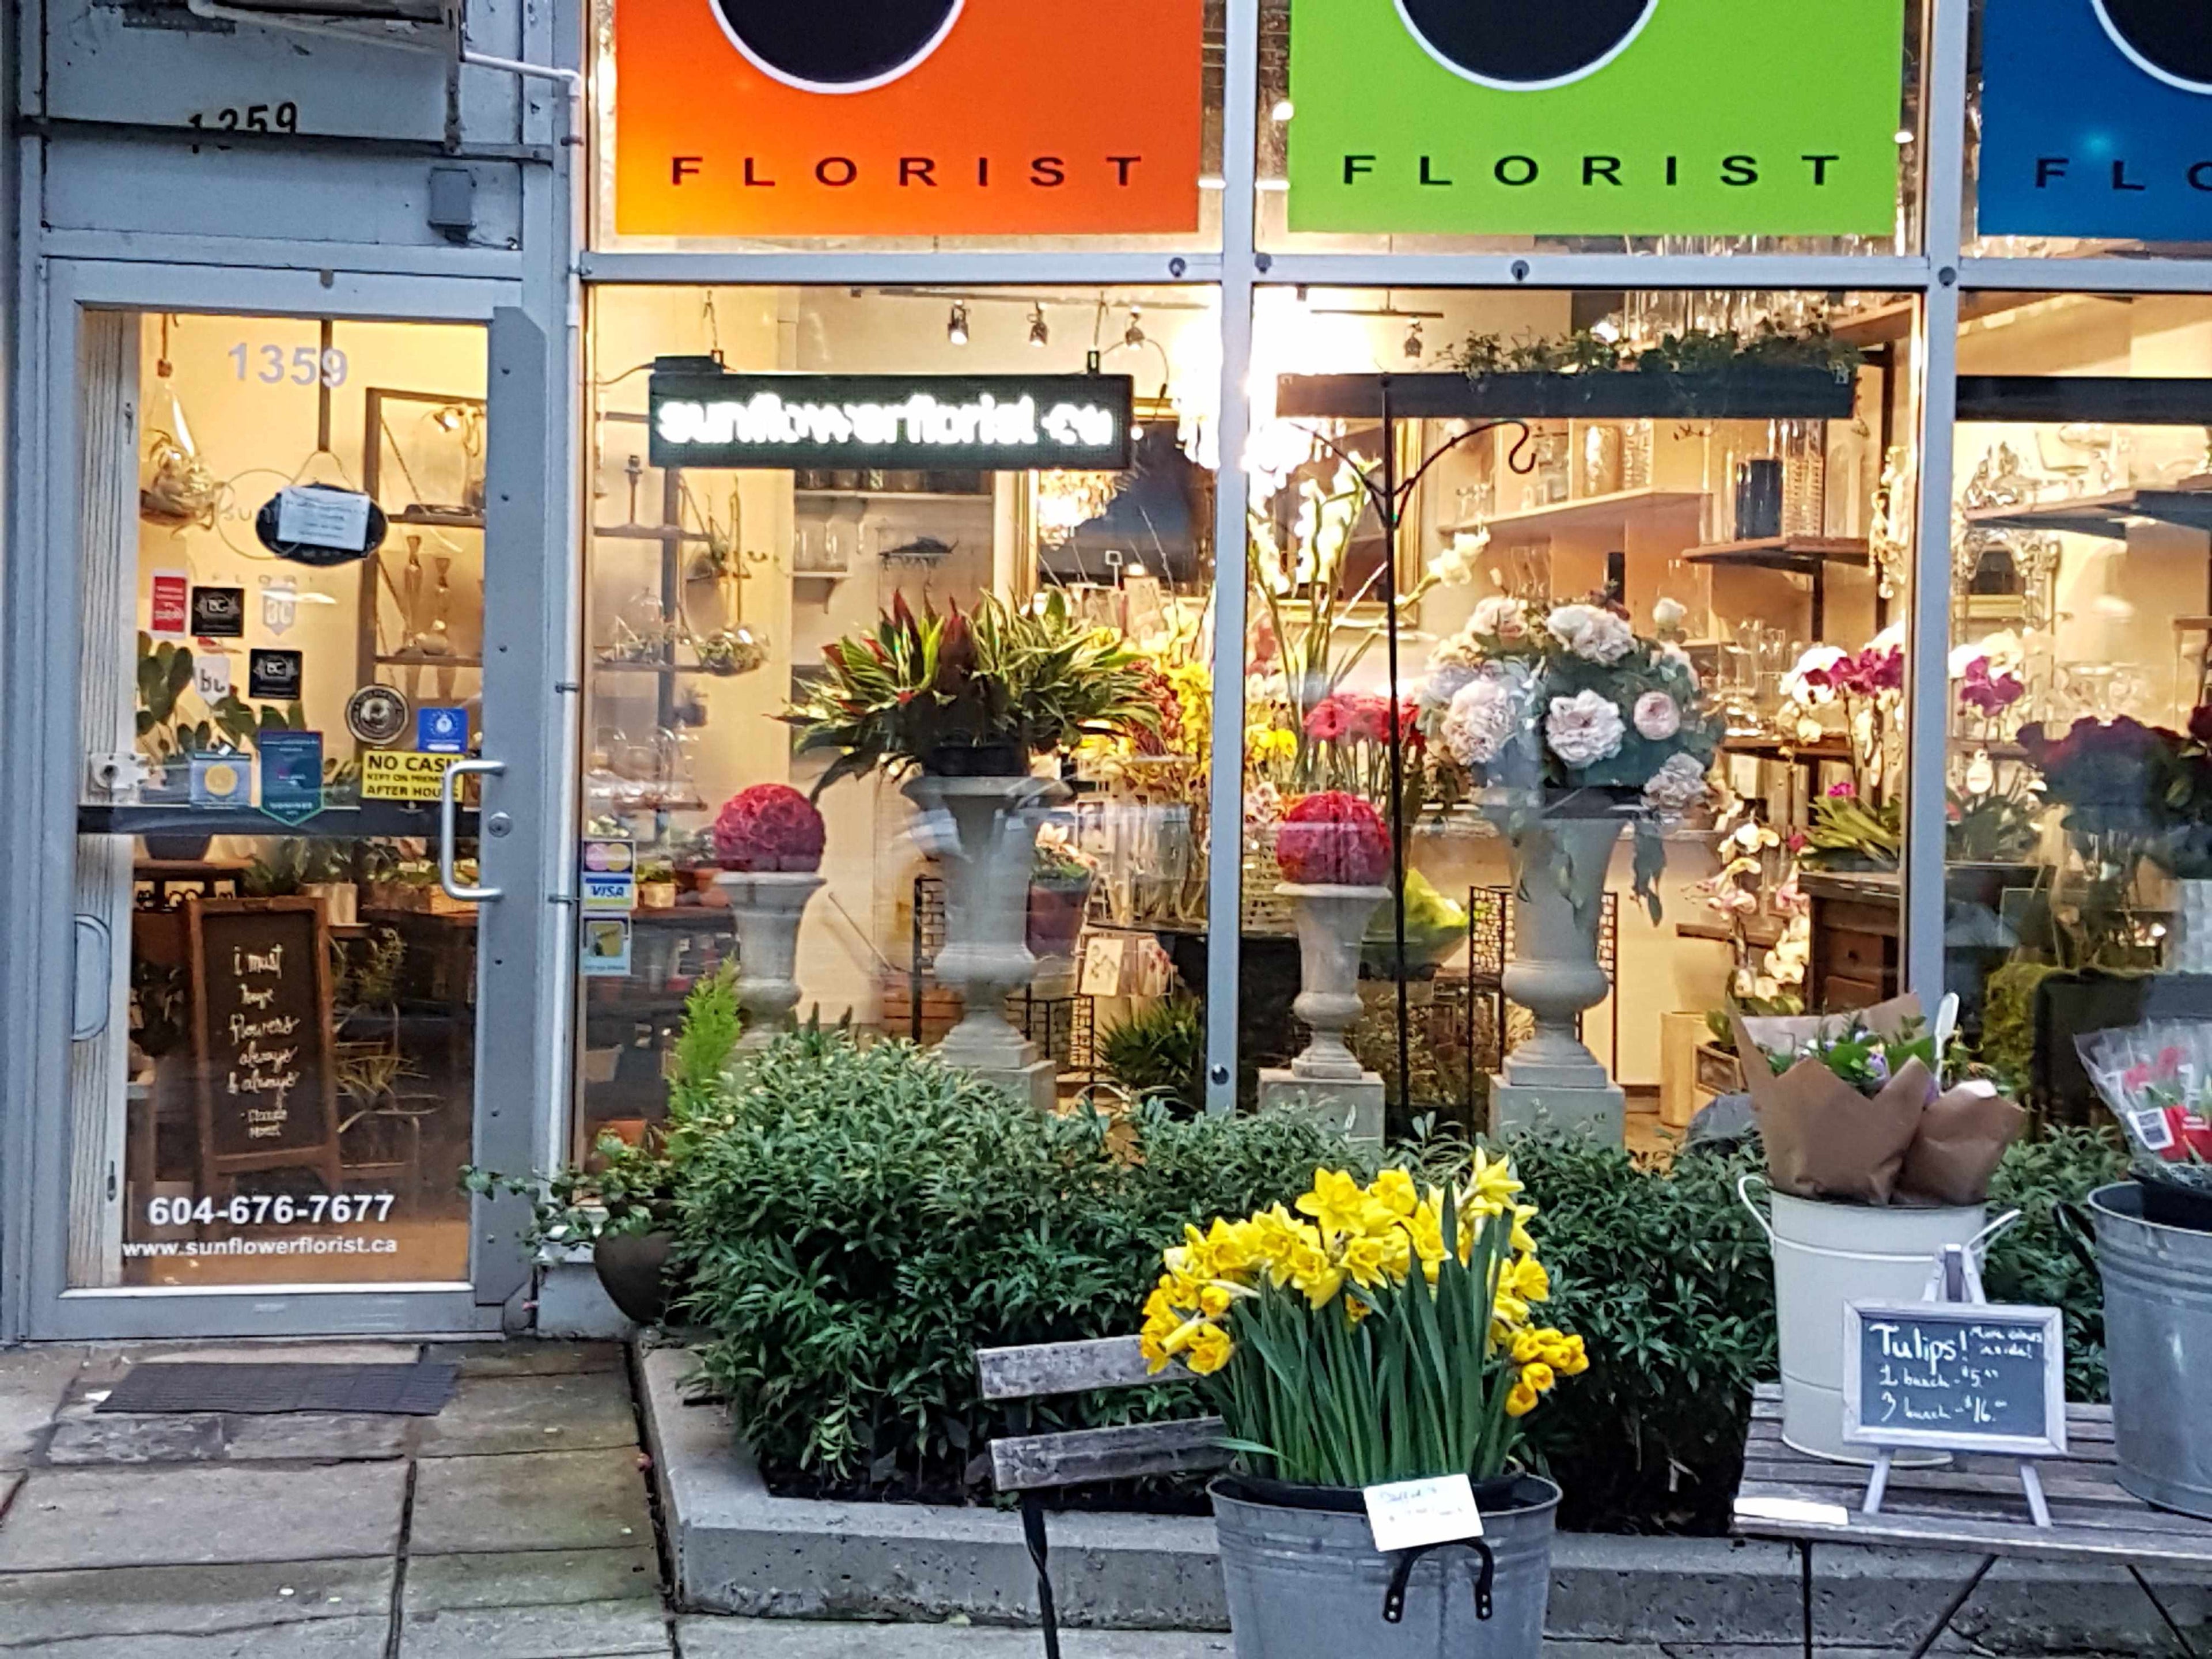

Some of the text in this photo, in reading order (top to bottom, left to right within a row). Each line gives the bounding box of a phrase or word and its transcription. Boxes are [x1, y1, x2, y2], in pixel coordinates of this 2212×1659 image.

[671, 156, 1142, 187] FLORIST
[1342, 155, 1839, 186] FLORIST
[228, 342, 349, 388] 1359
[369, 755, 398, 770] NO
[366, 784, 408, 796] AFTER
[592, 885, 624, 897] VISA
[229, 1013, 301, 1046] flowers
[238, 1040, 298, 1074] always
[241, 1068, 301, 1103] always
[148, 1194, 395, 1226] 604-676-7677
[122, 1236, 398, 1257] www.sunflowerflorist.ca
[1869, 1323, 1968, 1376] Tulips!
[1881, 1391, 1897, 1422] 3
